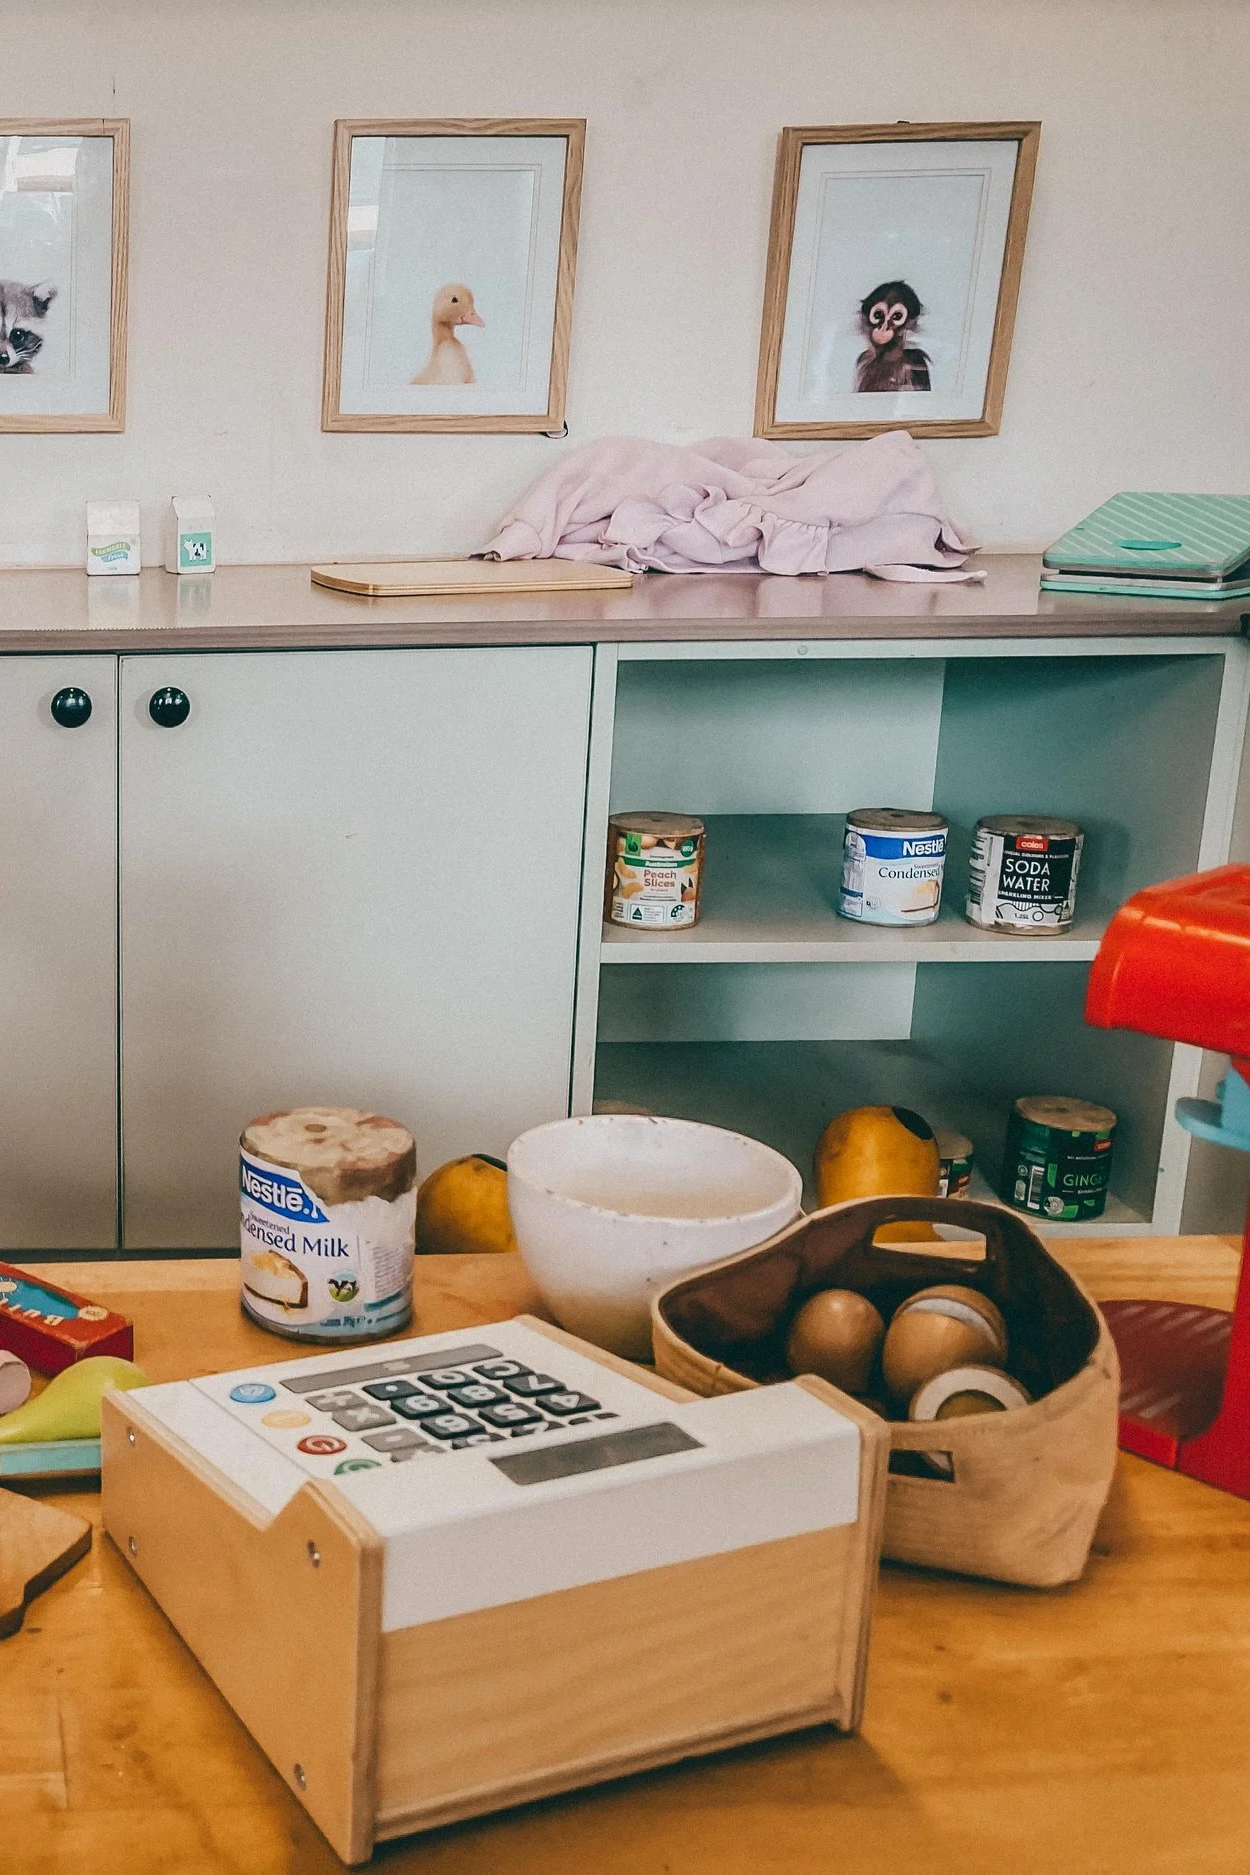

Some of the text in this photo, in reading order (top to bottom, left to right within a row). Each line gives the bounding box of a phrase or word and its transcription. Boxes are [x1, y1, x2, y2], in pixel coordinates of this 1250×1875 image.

[902, 839, 944, 856] Nestlé
[643, 869, 677, 879] Peach
[878, 864, 940, 879] Condensed
[1005, 858, 1050, 875] SODA
[643, 878, 675, 888] Slices
[1003, 874, 1050, 892] WATER
[248, 1211, 290, 1235] Sweetened
[303, 1236, 350, 1258] Milk
